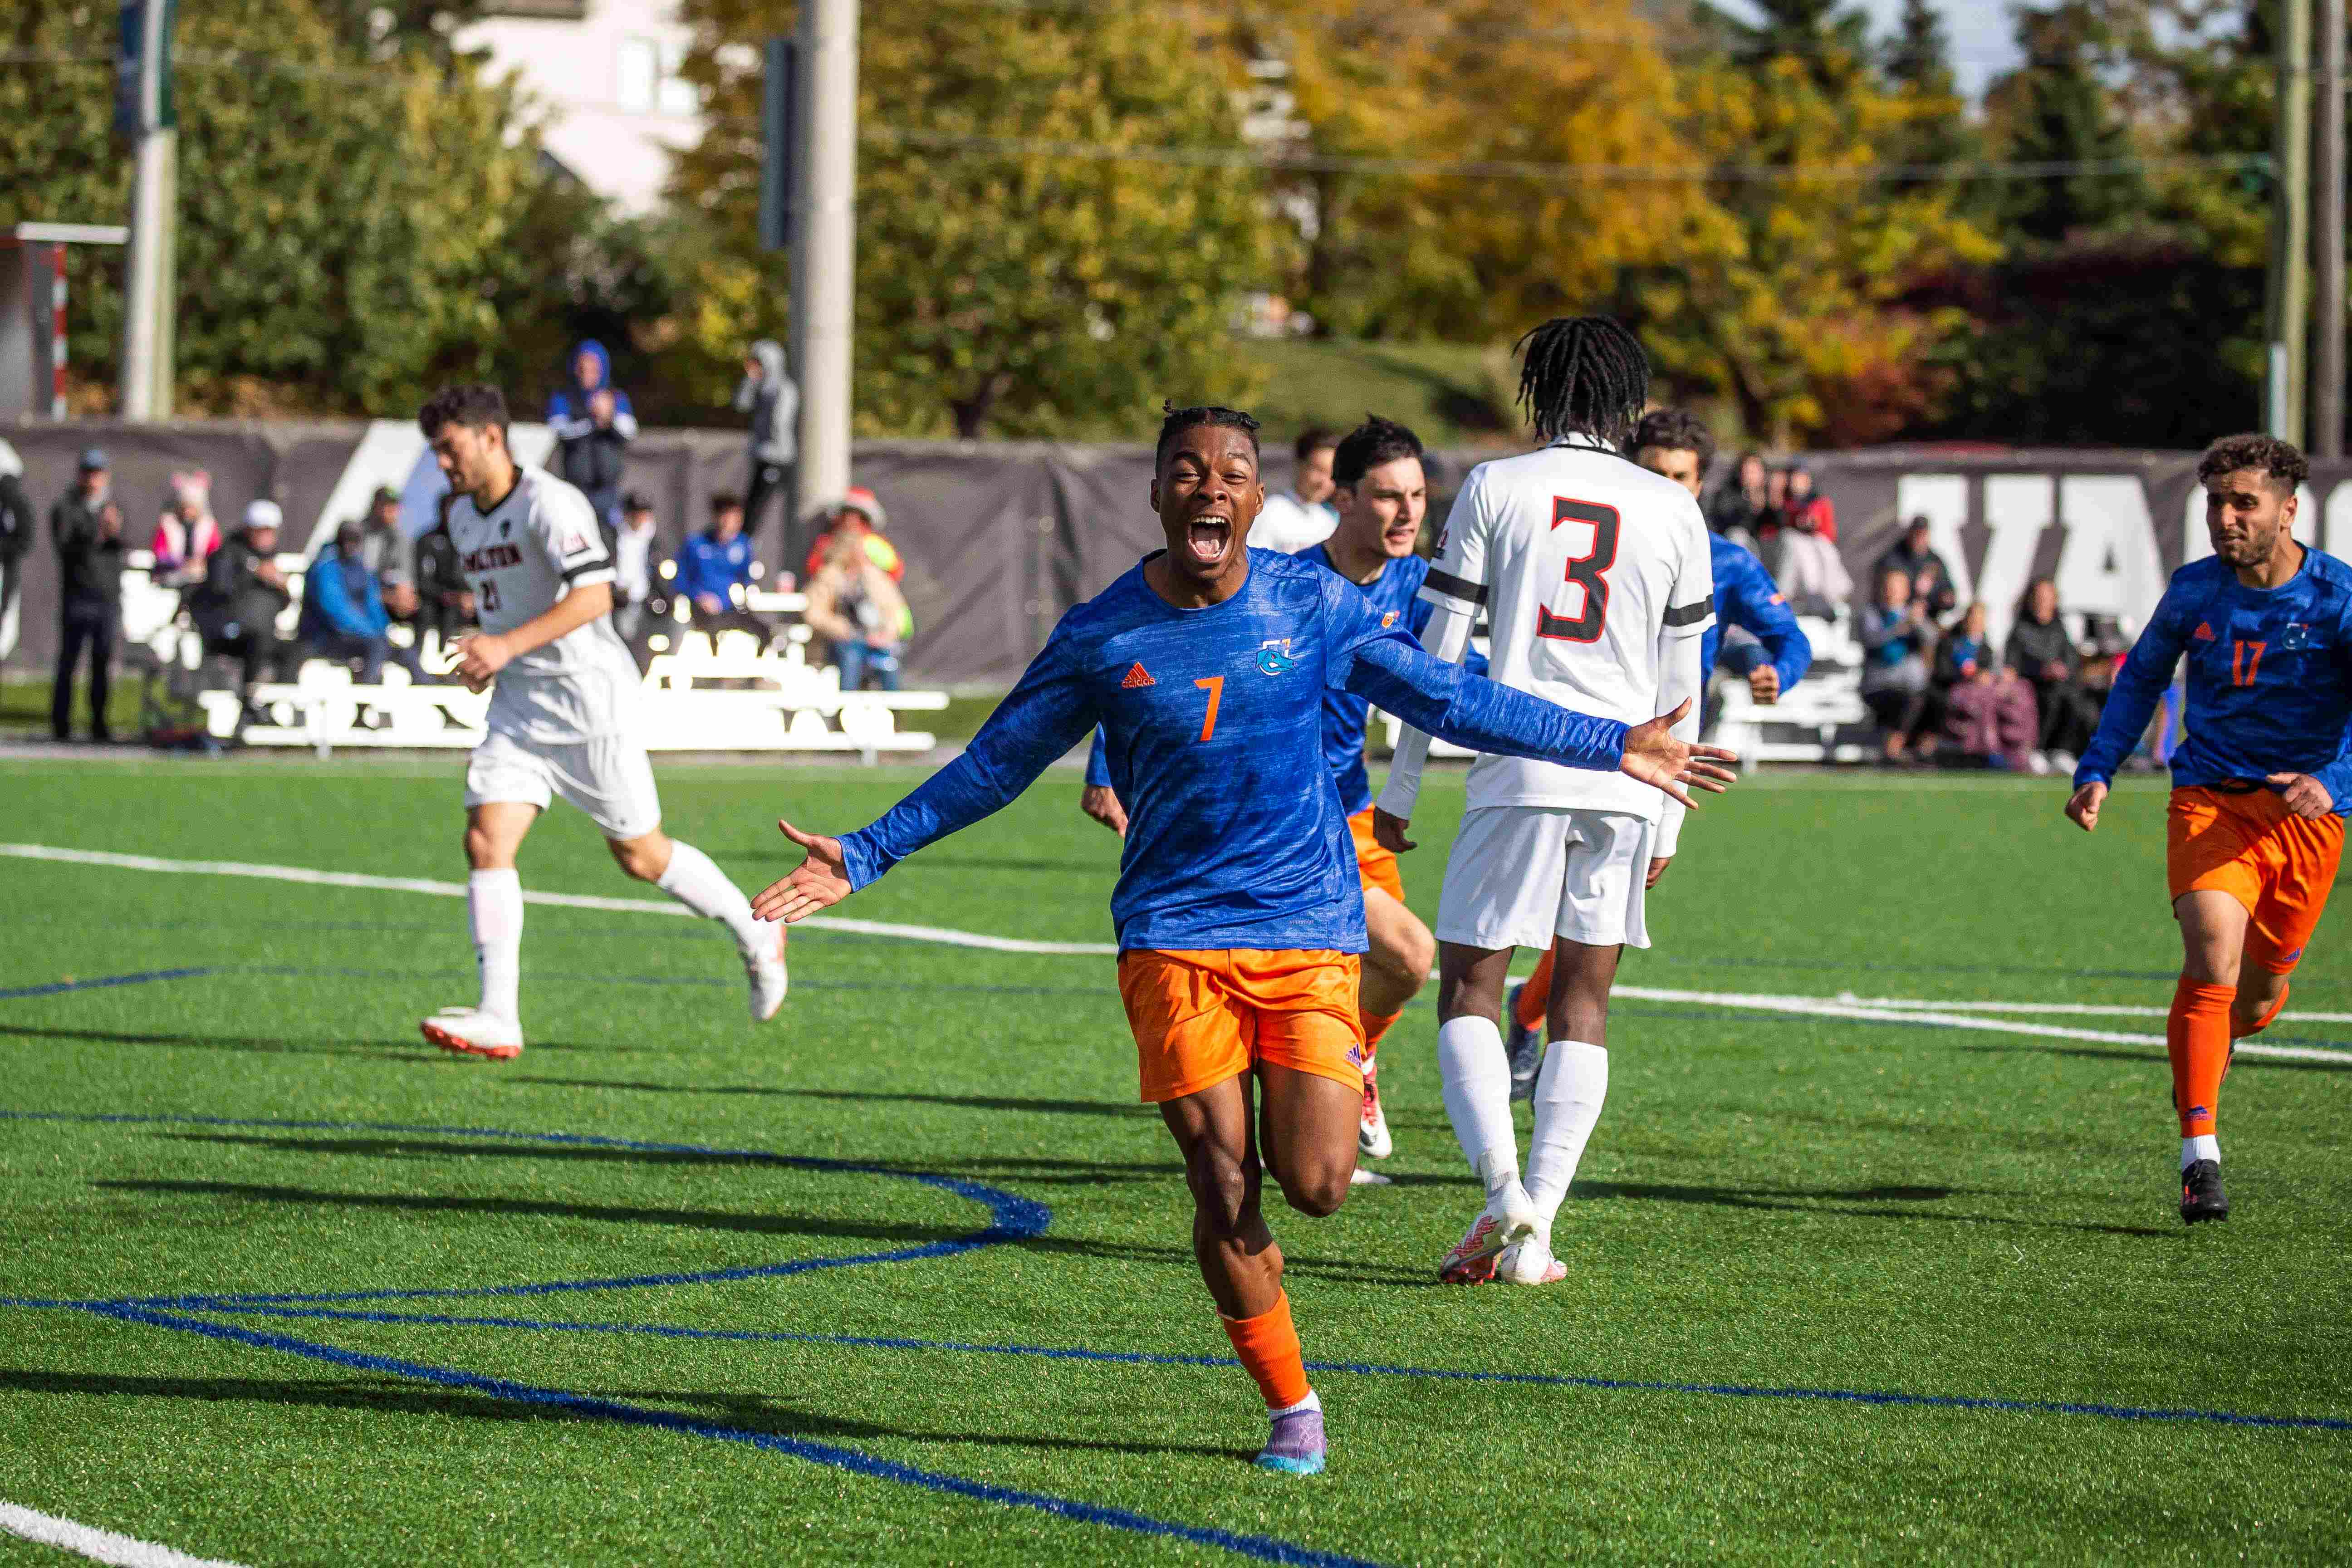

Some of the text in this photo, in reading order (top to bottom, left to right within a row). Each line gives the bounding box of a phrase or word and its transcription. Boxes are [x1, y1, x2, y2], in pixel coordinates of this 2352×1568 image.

[1537, 495, 1621, 643] 3
[1122, 677, 1156, 689] adidas
[2232, 639, 2268, 686] 17
[1194, 676, 1224, 741] 7
